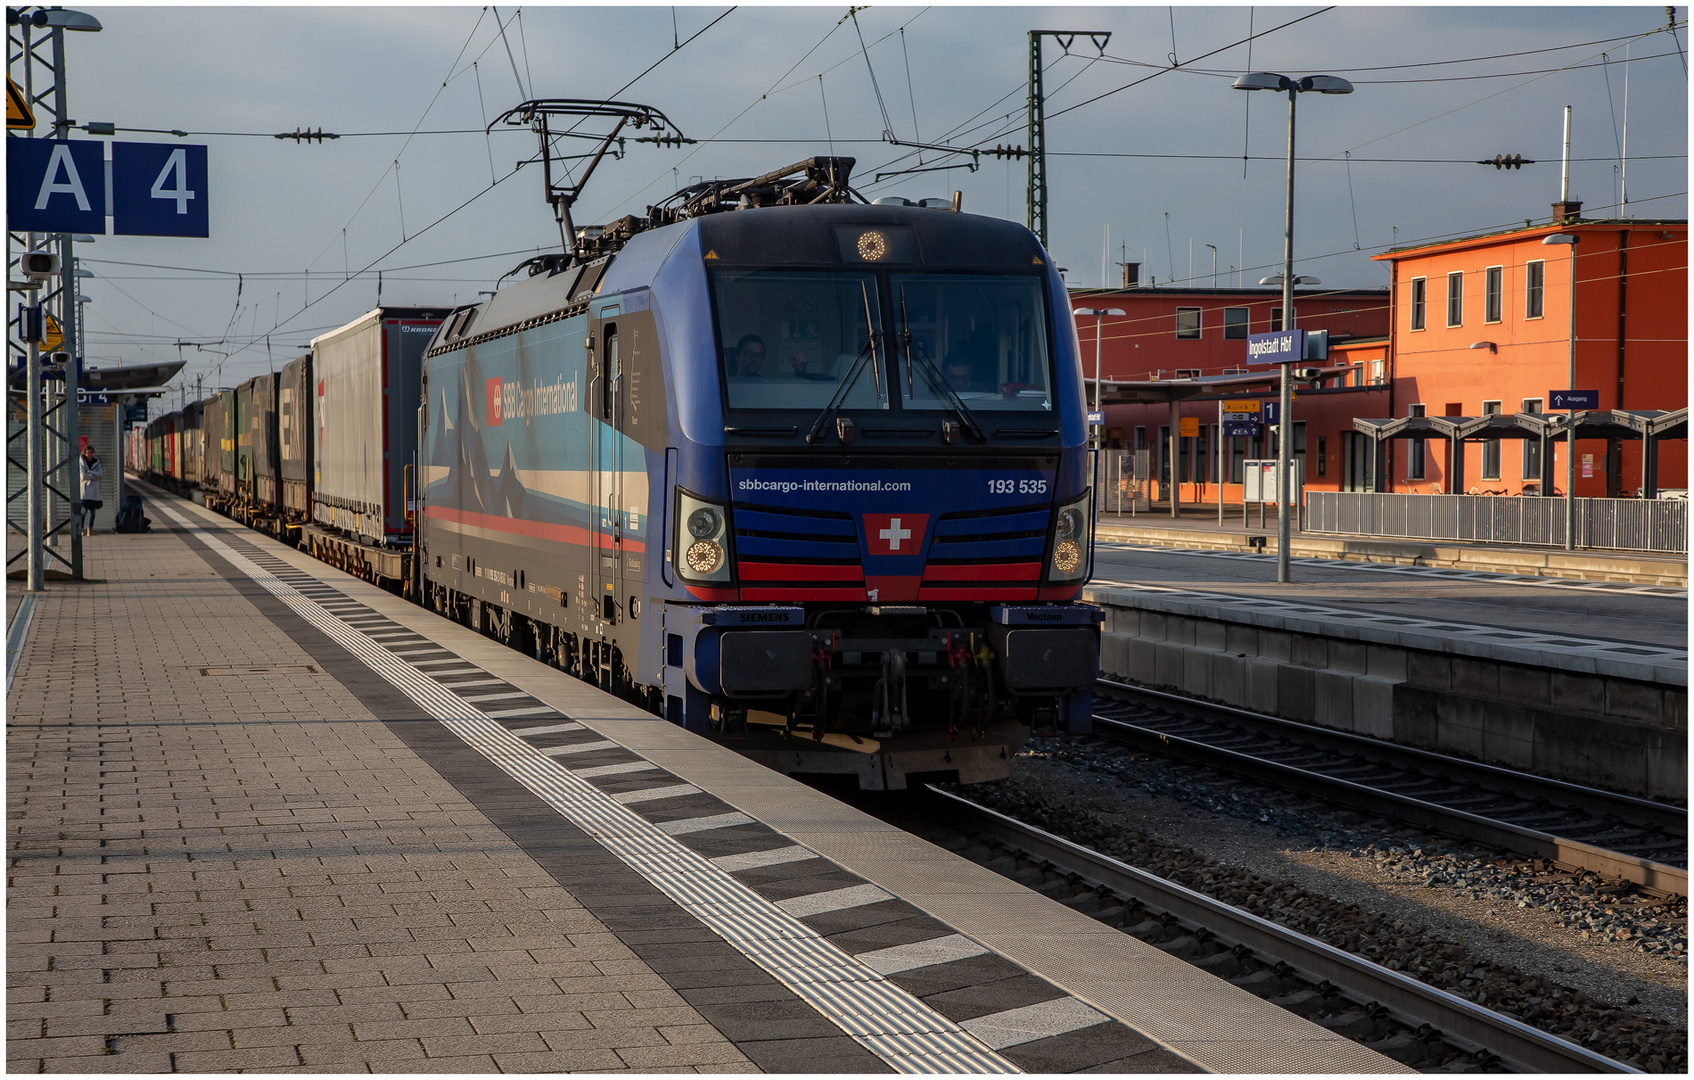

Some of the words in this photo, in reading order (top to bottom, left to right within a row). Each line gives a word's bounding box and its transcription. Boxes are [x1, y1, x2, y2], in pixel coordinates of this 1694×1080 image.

[34, 144, 92, 211] A
[150, 148, 195, 215] 4
[1249, 338, 1279, 359] Ingolstadt
[1280, 336, 1292, 352] Hbf
[503, 382, 516, 420] SBB
[516, 380, 534, 427] Cargo
[534, 370, 578, 416] International
[1266, 403, 1273, 419] 1
[739, 479, 911, 493] sbbcargo-international.com
[988, 479, 1015, 494] 193
[1019, 479, 1047, 494] 535
[740, 613, 790, 622] SIEMENS
[1026, 612, 1063, 621] Vectron
